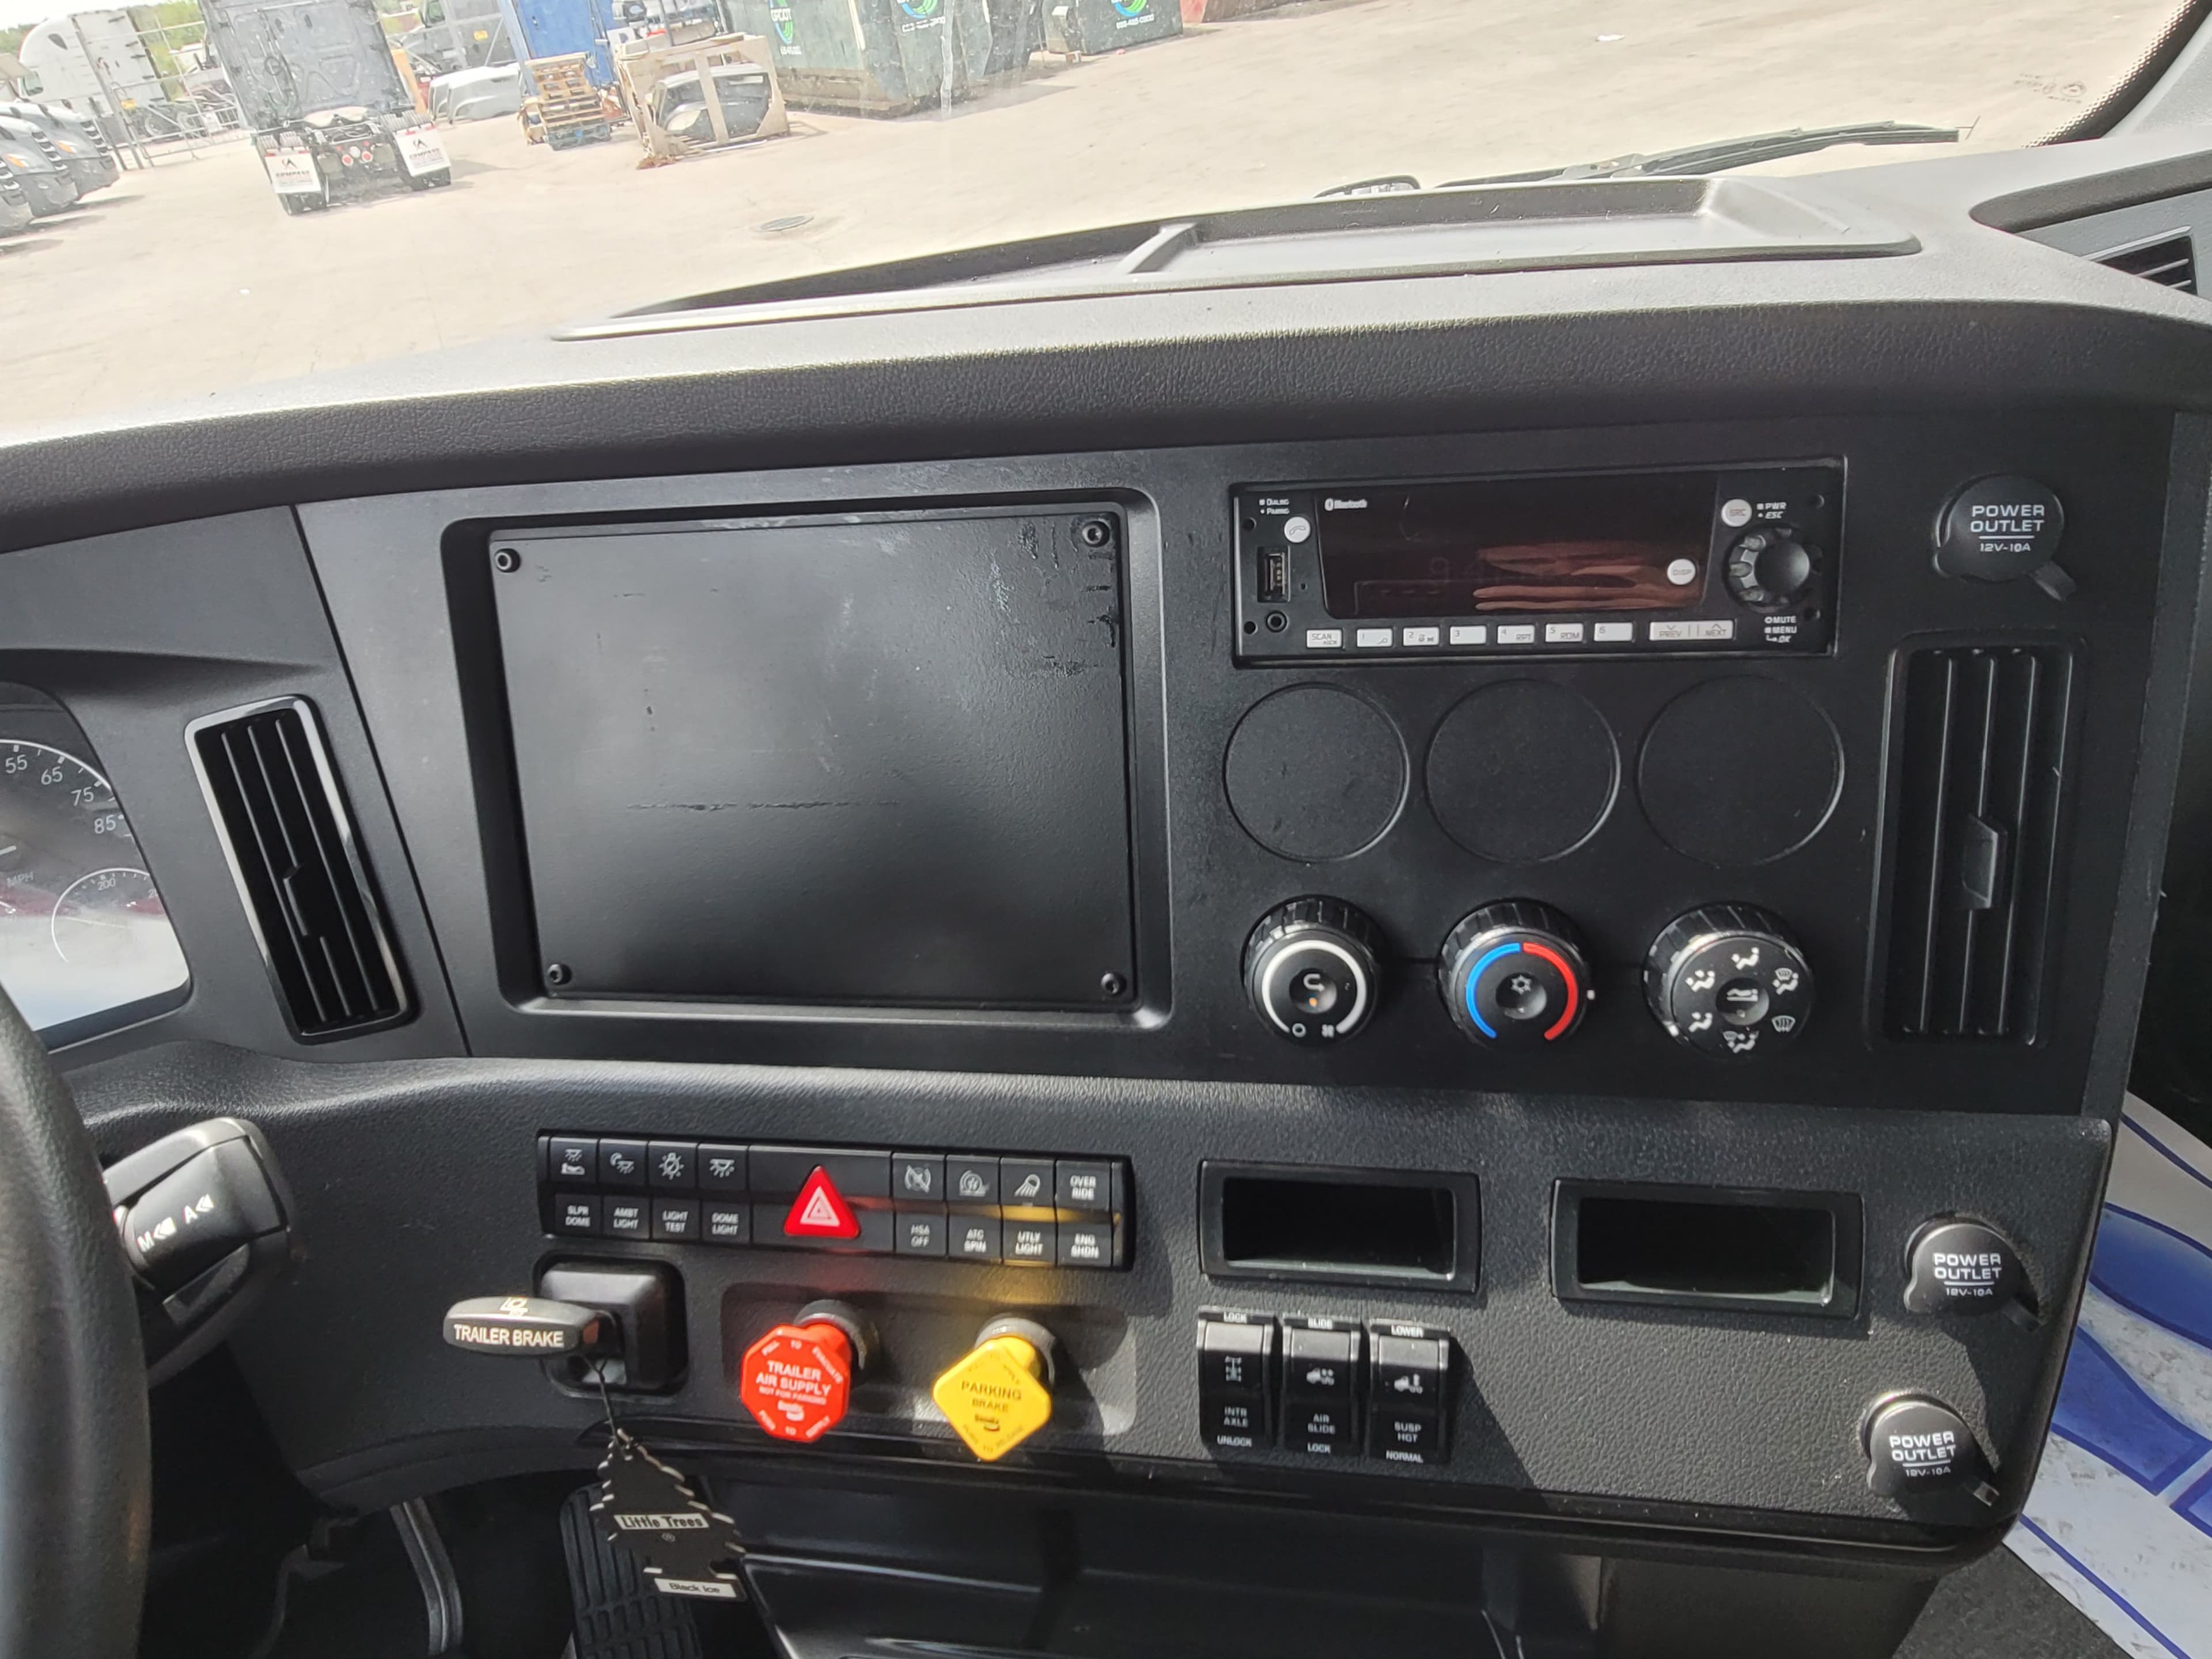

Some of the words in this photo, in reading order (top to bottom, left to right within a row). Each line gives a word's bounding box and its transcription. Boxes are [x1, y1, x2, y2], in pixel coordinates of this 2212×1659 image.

[1972, 505, 2044, 517] POWER
[1971, 520, 2044, 532] OUTLET
[1980, 543, 2031, 552] 12V-10A
[5, 754, 27, 773] 55
[41, 766, 63, 785] 65
[71, 786, 94, 806] 75
[94, 815, 116, 834] 85
[7, 871, 34, 887] MPH
[97, 877, 116, 891] 200
[1070, 1175, 1096, 1188] OVER
[1071, 1188, 1094, 1200] RIDE
[183, 1205, 198, 1224] A
[663, 1210, 688, 1220] LIGHT
[711, 1213, 738, 1223] DOME
[565, 1216, 590, 1227] DOME
[613, 1218, 638, 1229] LIGHT
[712, 1224, 738, 1235] LIGHT
[911, 1224, 930, 1236] HSA
[137, 1230, 155, 1252] M
[911, 1236, 929, 1247] OFF
[1074, 1233, 1096, 1245] ENG
[1015, 1242, 1043, 1255] LIGHT
[1934, 1252, 2001, 1266] POWER
[1934, 1268, 2002, 1280] OUTLET
[1224, 1312, 1247, 1323] LOCK
[1308, 1319, 1333, 1330] SLIDE
[454, 1324, 510, 1345] TRAILER
[512, 1331, 564, 1347] BRAKE
[1391, 1325, 1425, 1338] LOWER
[767, 1360, 821, 1381] TRAILER
[756, 1372, 777, 1387] AIR
[781, 1377, 831, 1396] SUPPLY
[961, 1380, 1021, 1400] PARKING
[972, 1397, 1008, 1412] BRAKE
[1224, 1416, 1249, 1427] AXLE
[1313, 1413, 1330, 1423] AIR
[1308, 1423, 1335, 1434] SLIDE
[1394, 1421, 1422, 1432] SUSP
[1217, 1435, 1252, 1447] UNLOCK
[1397, 1432, 1418, 1442] HGT
[1889, 1431, 1955, 1448] POWER
[1308, 1442, 1331, 1453] LOCK
[1892, 1445, 1956, 1461] OUTLET
[1386, 1450, 1423, 1463] NORMAL
[621, 1515, 660, 1528] Little
[664, 1515, 703, 1527] Trees
[668, 1582, 700, 1592] Black
